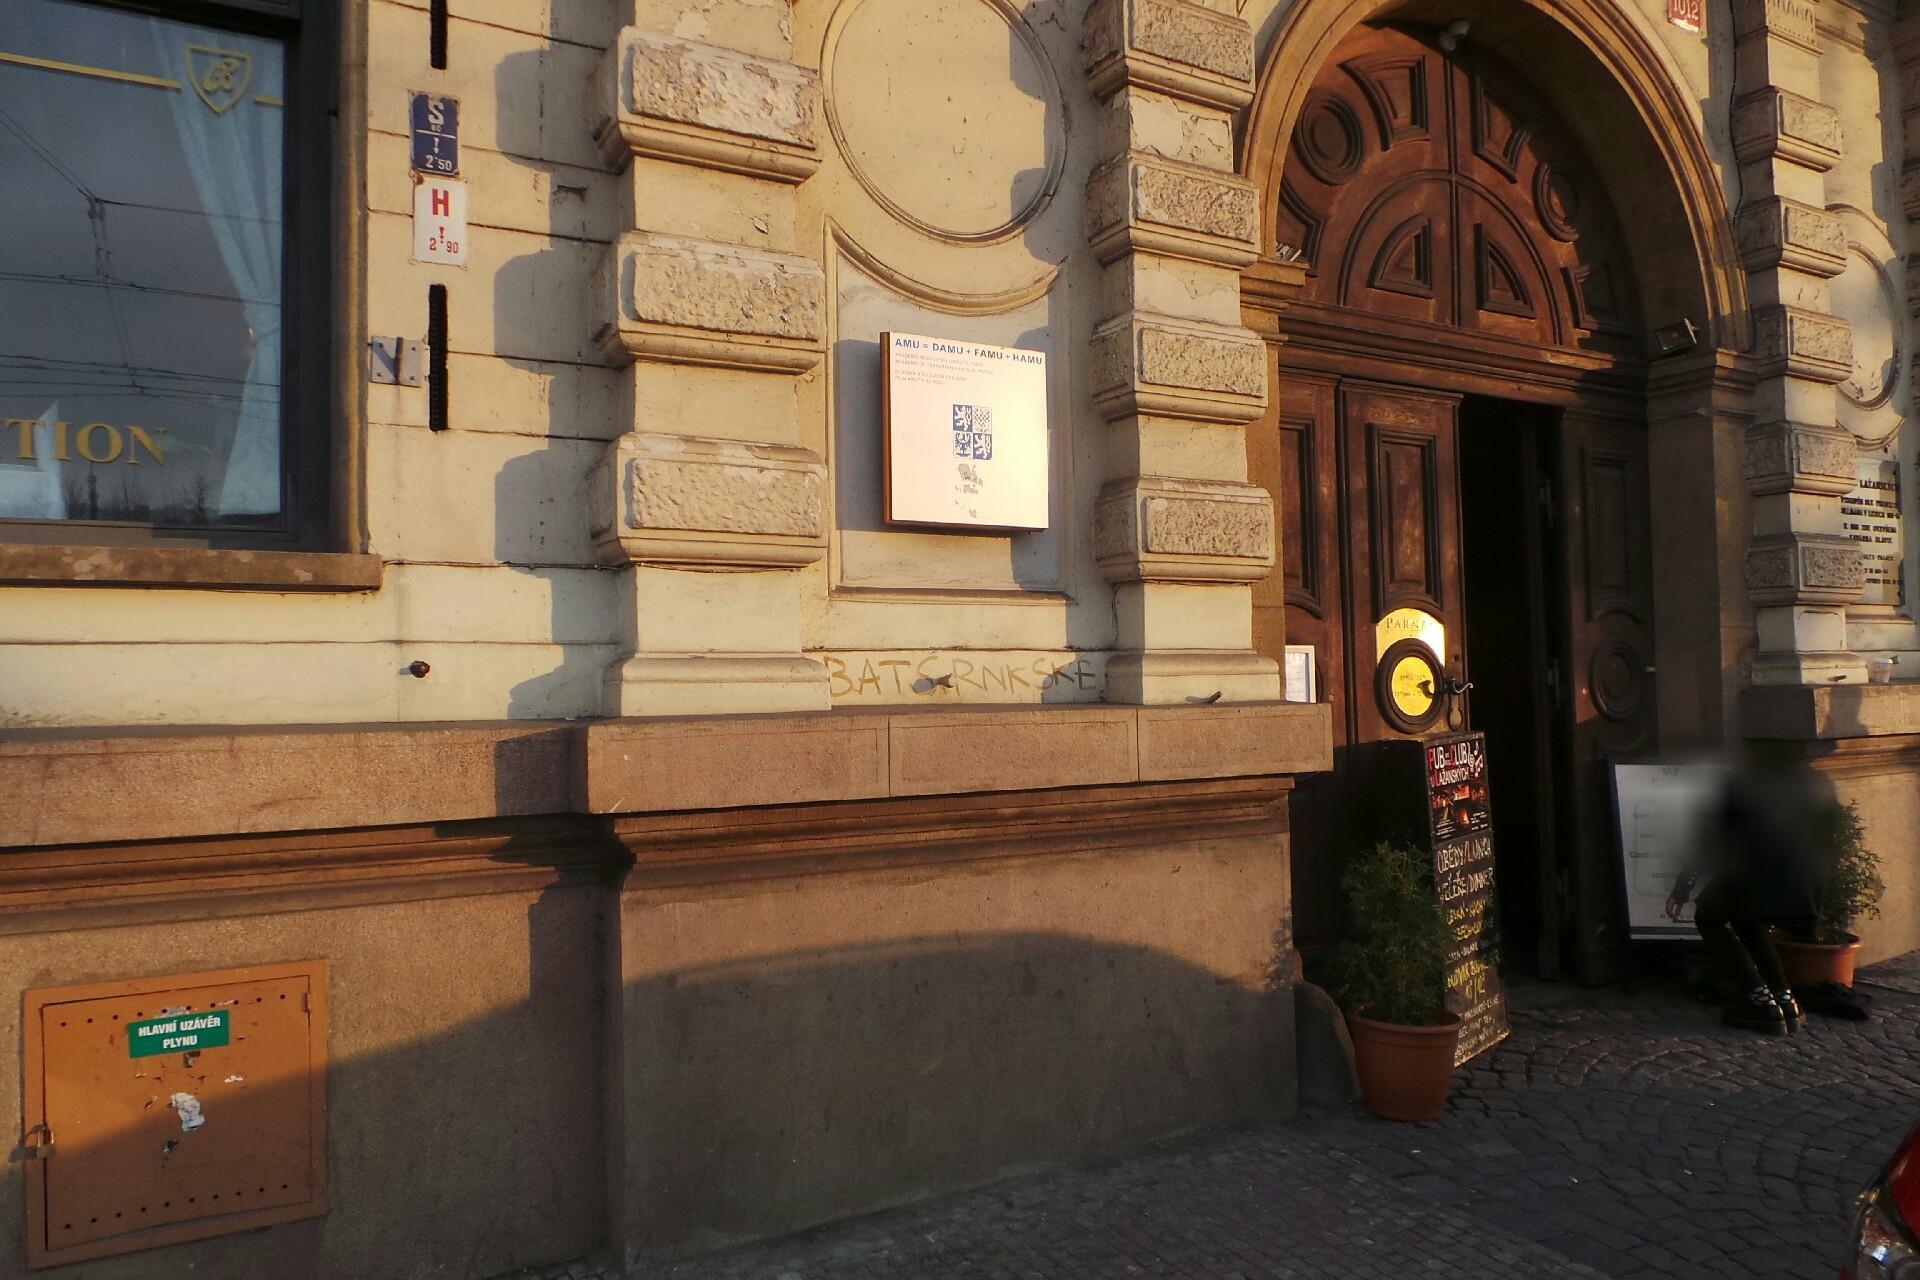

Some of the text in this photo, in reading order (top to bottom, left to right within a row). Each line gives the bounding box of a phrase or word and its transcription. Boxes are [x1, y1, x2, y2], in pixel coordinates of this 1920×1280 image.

[432, 188, 450, 217] H
[895, 338, 920, 349] AMU
[932, 343, 964, 355] DAMU
[974, 349, 1003, 360] FAMU
[1012, 353, 1043, 365] HAMU
[0, 417, 168, 465] TION
[138, 1021, 177, 1037] HLAVNÍ
[163, 1035, 198, 1049] PLYNU
